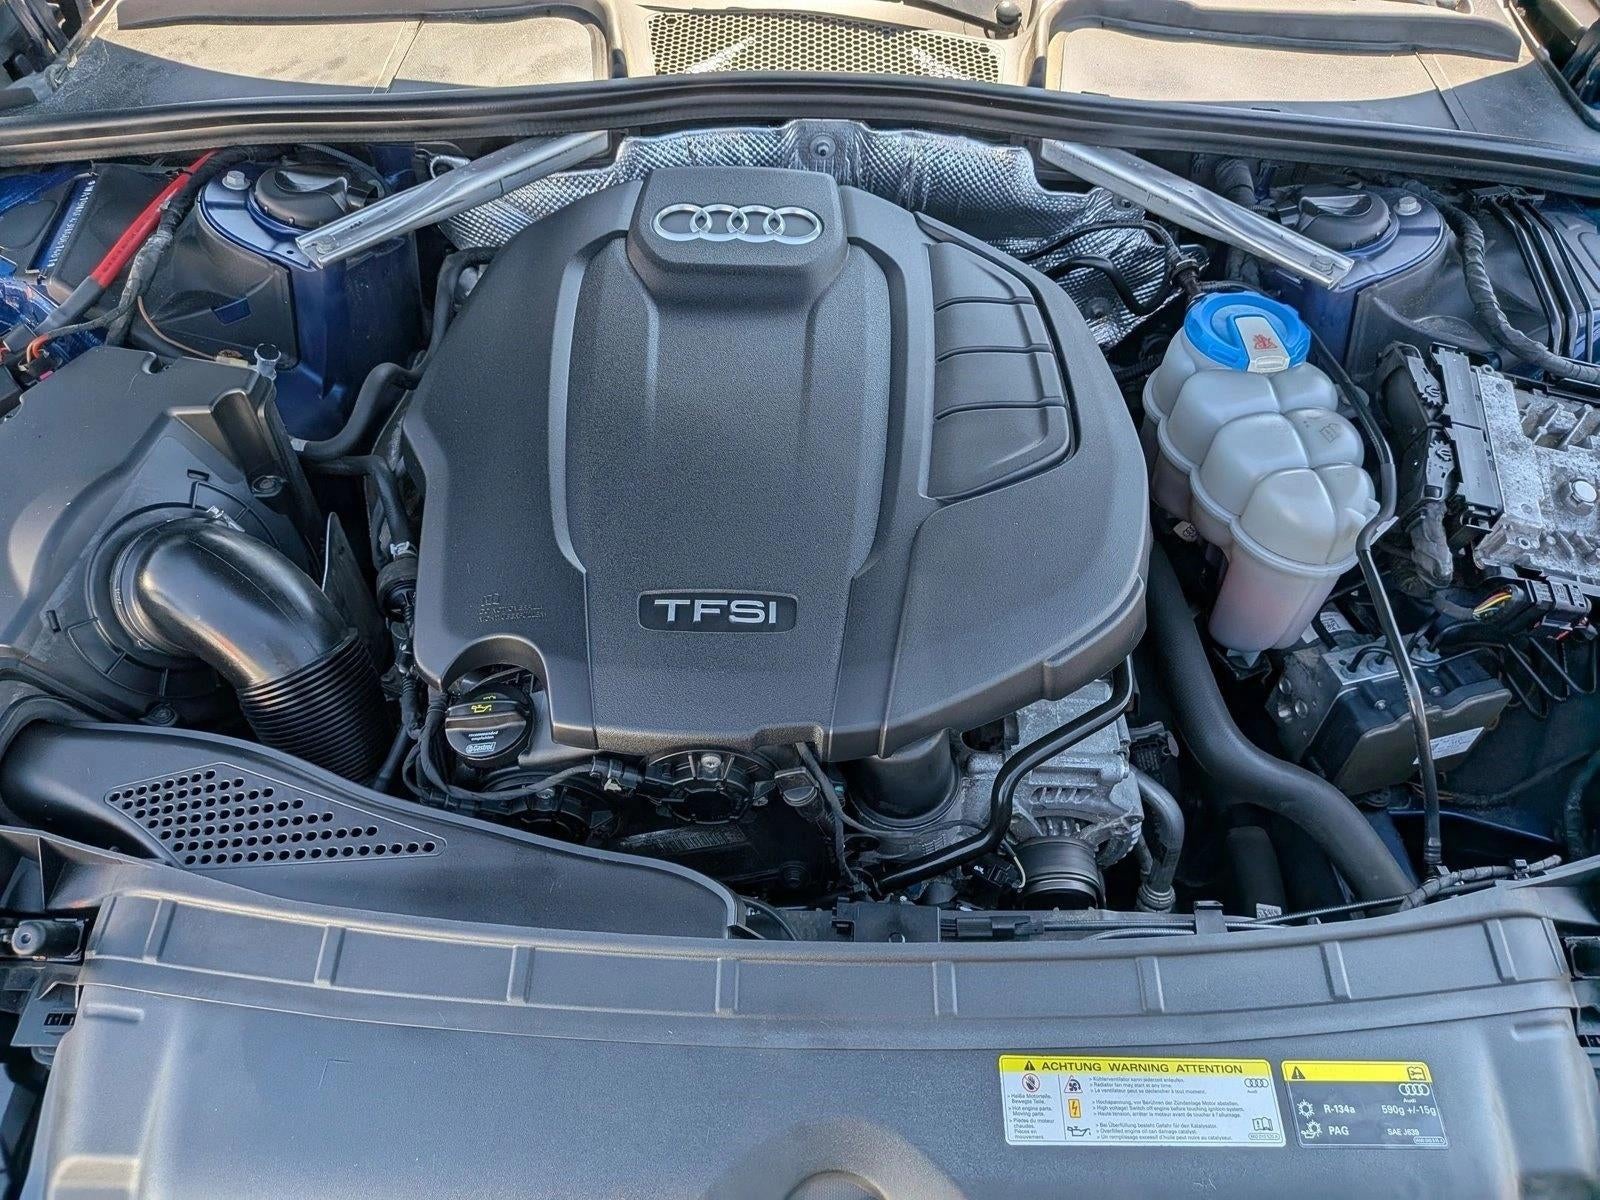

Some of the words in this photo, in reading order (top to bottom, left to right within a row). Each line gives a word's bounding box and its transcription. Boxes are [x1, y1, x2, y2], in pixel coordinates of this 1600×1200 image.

[654, 600, 776, 624] TFSI
[1042, 1062, 1102, 1072] ACHTUNG
[1108, 1062, 1169, 1072] WARNING
[1176, 1064, 1243, 1074] ATTENTION
[1324, 1104, 1356, 1114] R-134a
[1381, 1105, 1405, 1116] 590g
[1407, 1106, 1437, 1116] +/-15g
[1328, 1126, 1350, 1136] PAG
